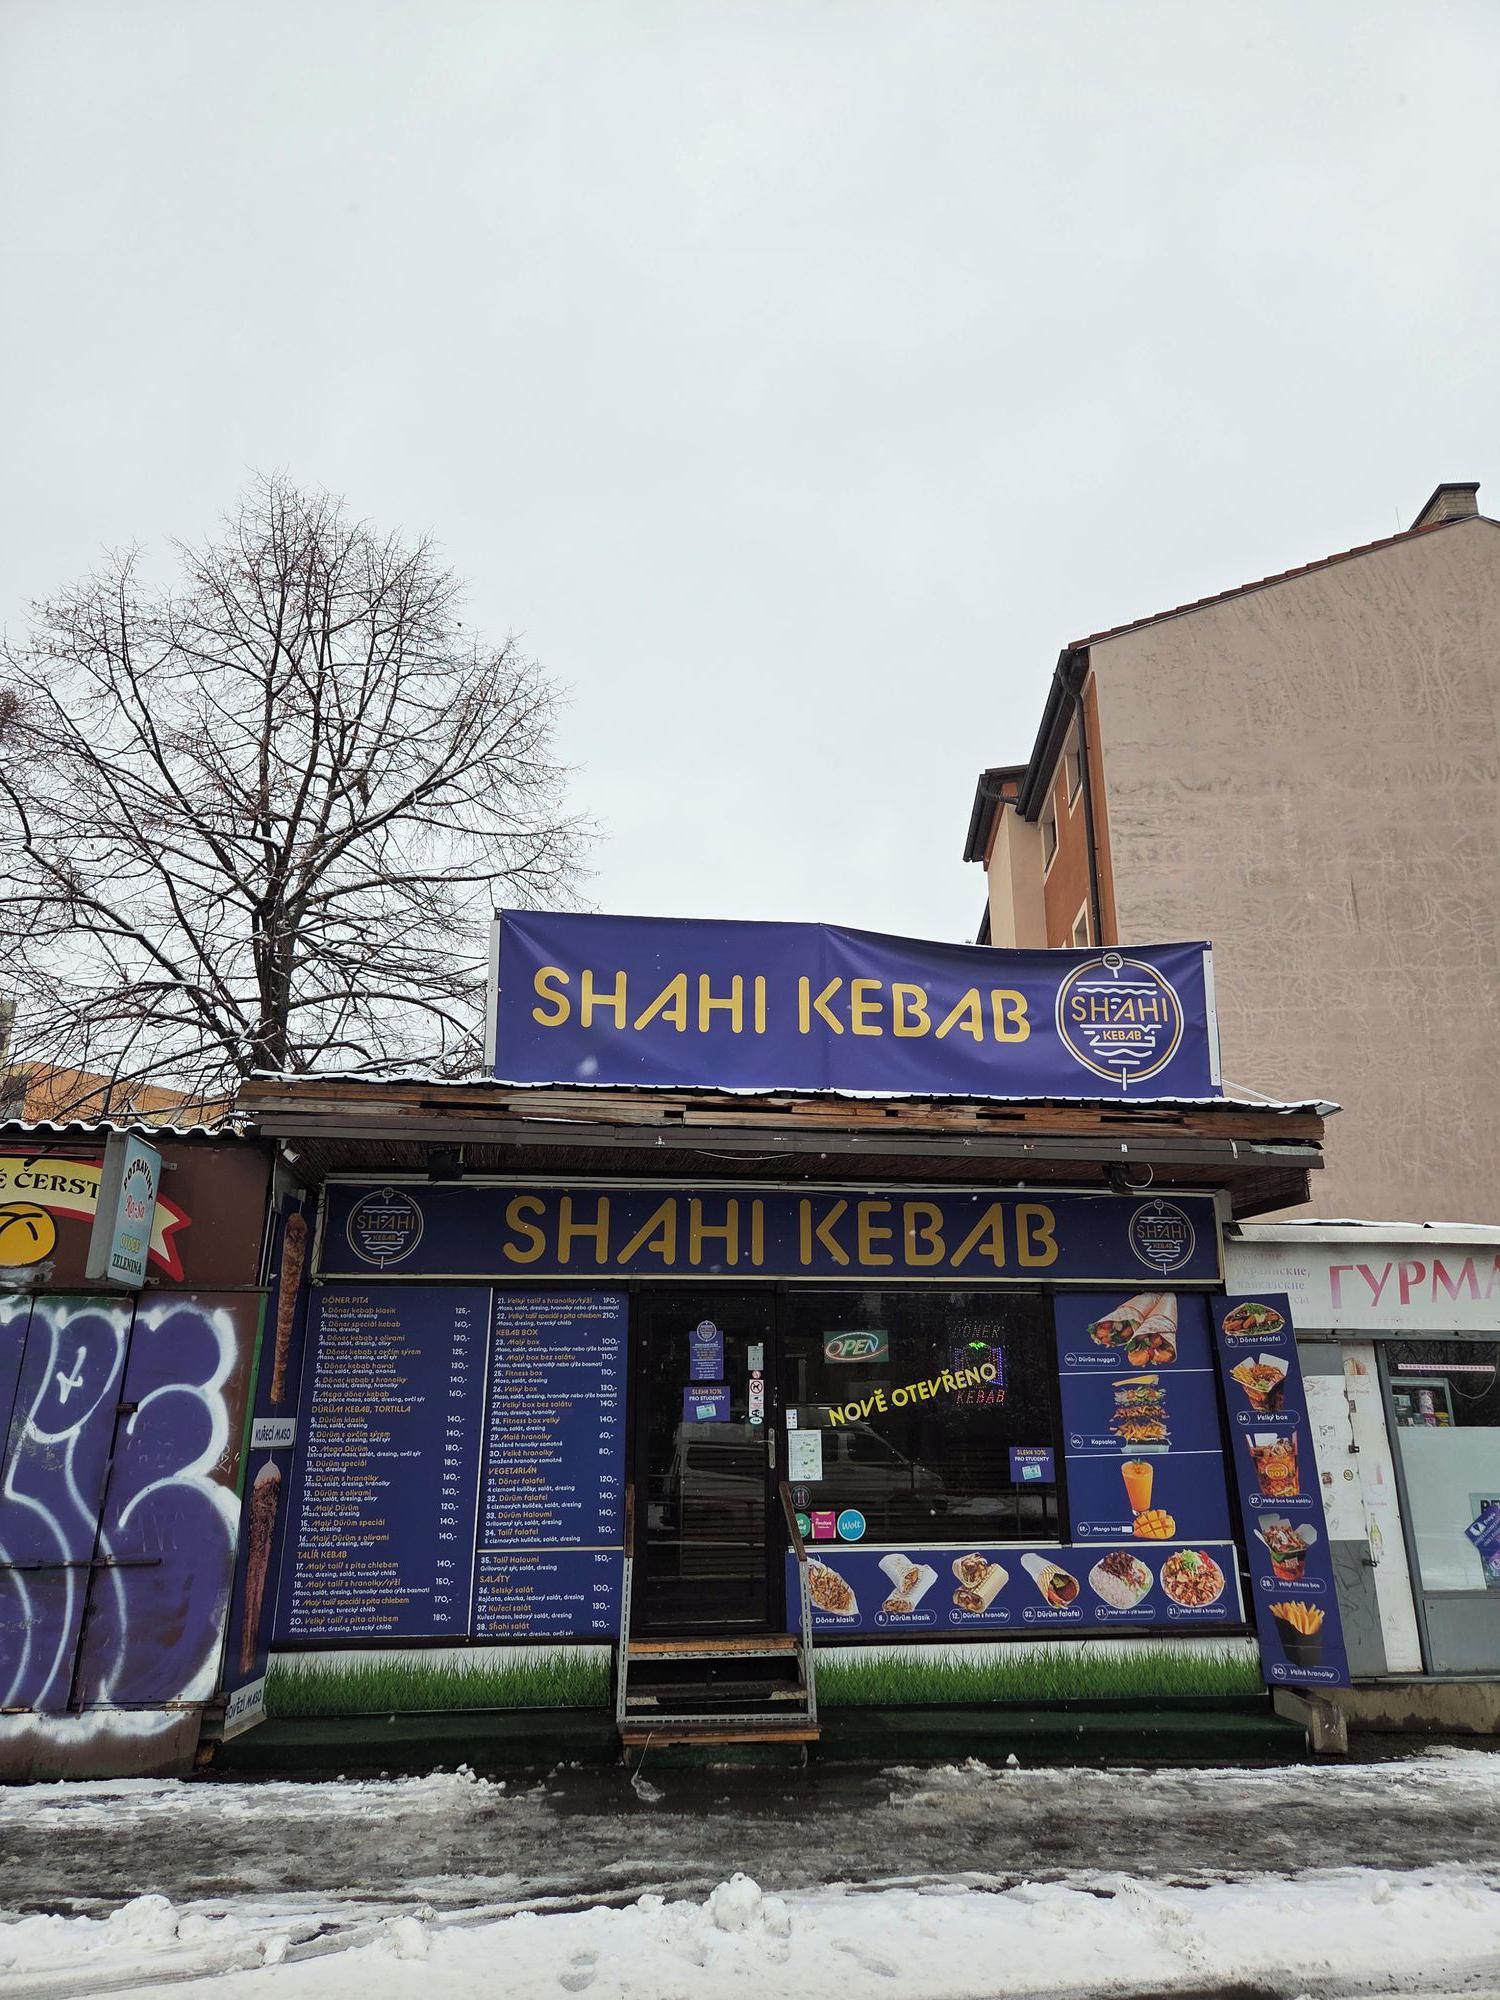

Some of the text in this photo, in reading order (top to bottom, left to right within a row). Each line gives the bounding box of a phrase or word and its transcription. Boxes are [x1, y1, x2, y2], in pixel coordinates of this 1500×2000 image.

[532, 966, 1031, 1043] SHAHI KEBAB
[1071, 996, 1168, 1021] SHAHI
[1103, 1030, 1142, 1040] KEBAB
[357, 1215, 414, 1230] SHAHI
[503, 1195, 1059, 1268] SHAHI KEBAB
[1137, 1225, 1186, 1238] SHAHI
[112, 1254, 142, 1275] ZELENINA
[322, 1296, 369, 1304] DÖNER PITA
[828, 1340, 876, 1356] OPEN
[828, 1362, 996, 1427] NOVĚ OTEVŘENO
[312, 1404, 343, 1413] DÜRÜM
[274, 1429, 290, 1440] MASO
[521, 1433, 551, 1441] hranolky
[488, 1464, 537, 1475] VEGETARIÁN
[842, 1520, 861, 1530] Wolt
[480, 1574, 510, 1583] SALÁTY
[1037, 1610, 1058, 1618] Dürüm
